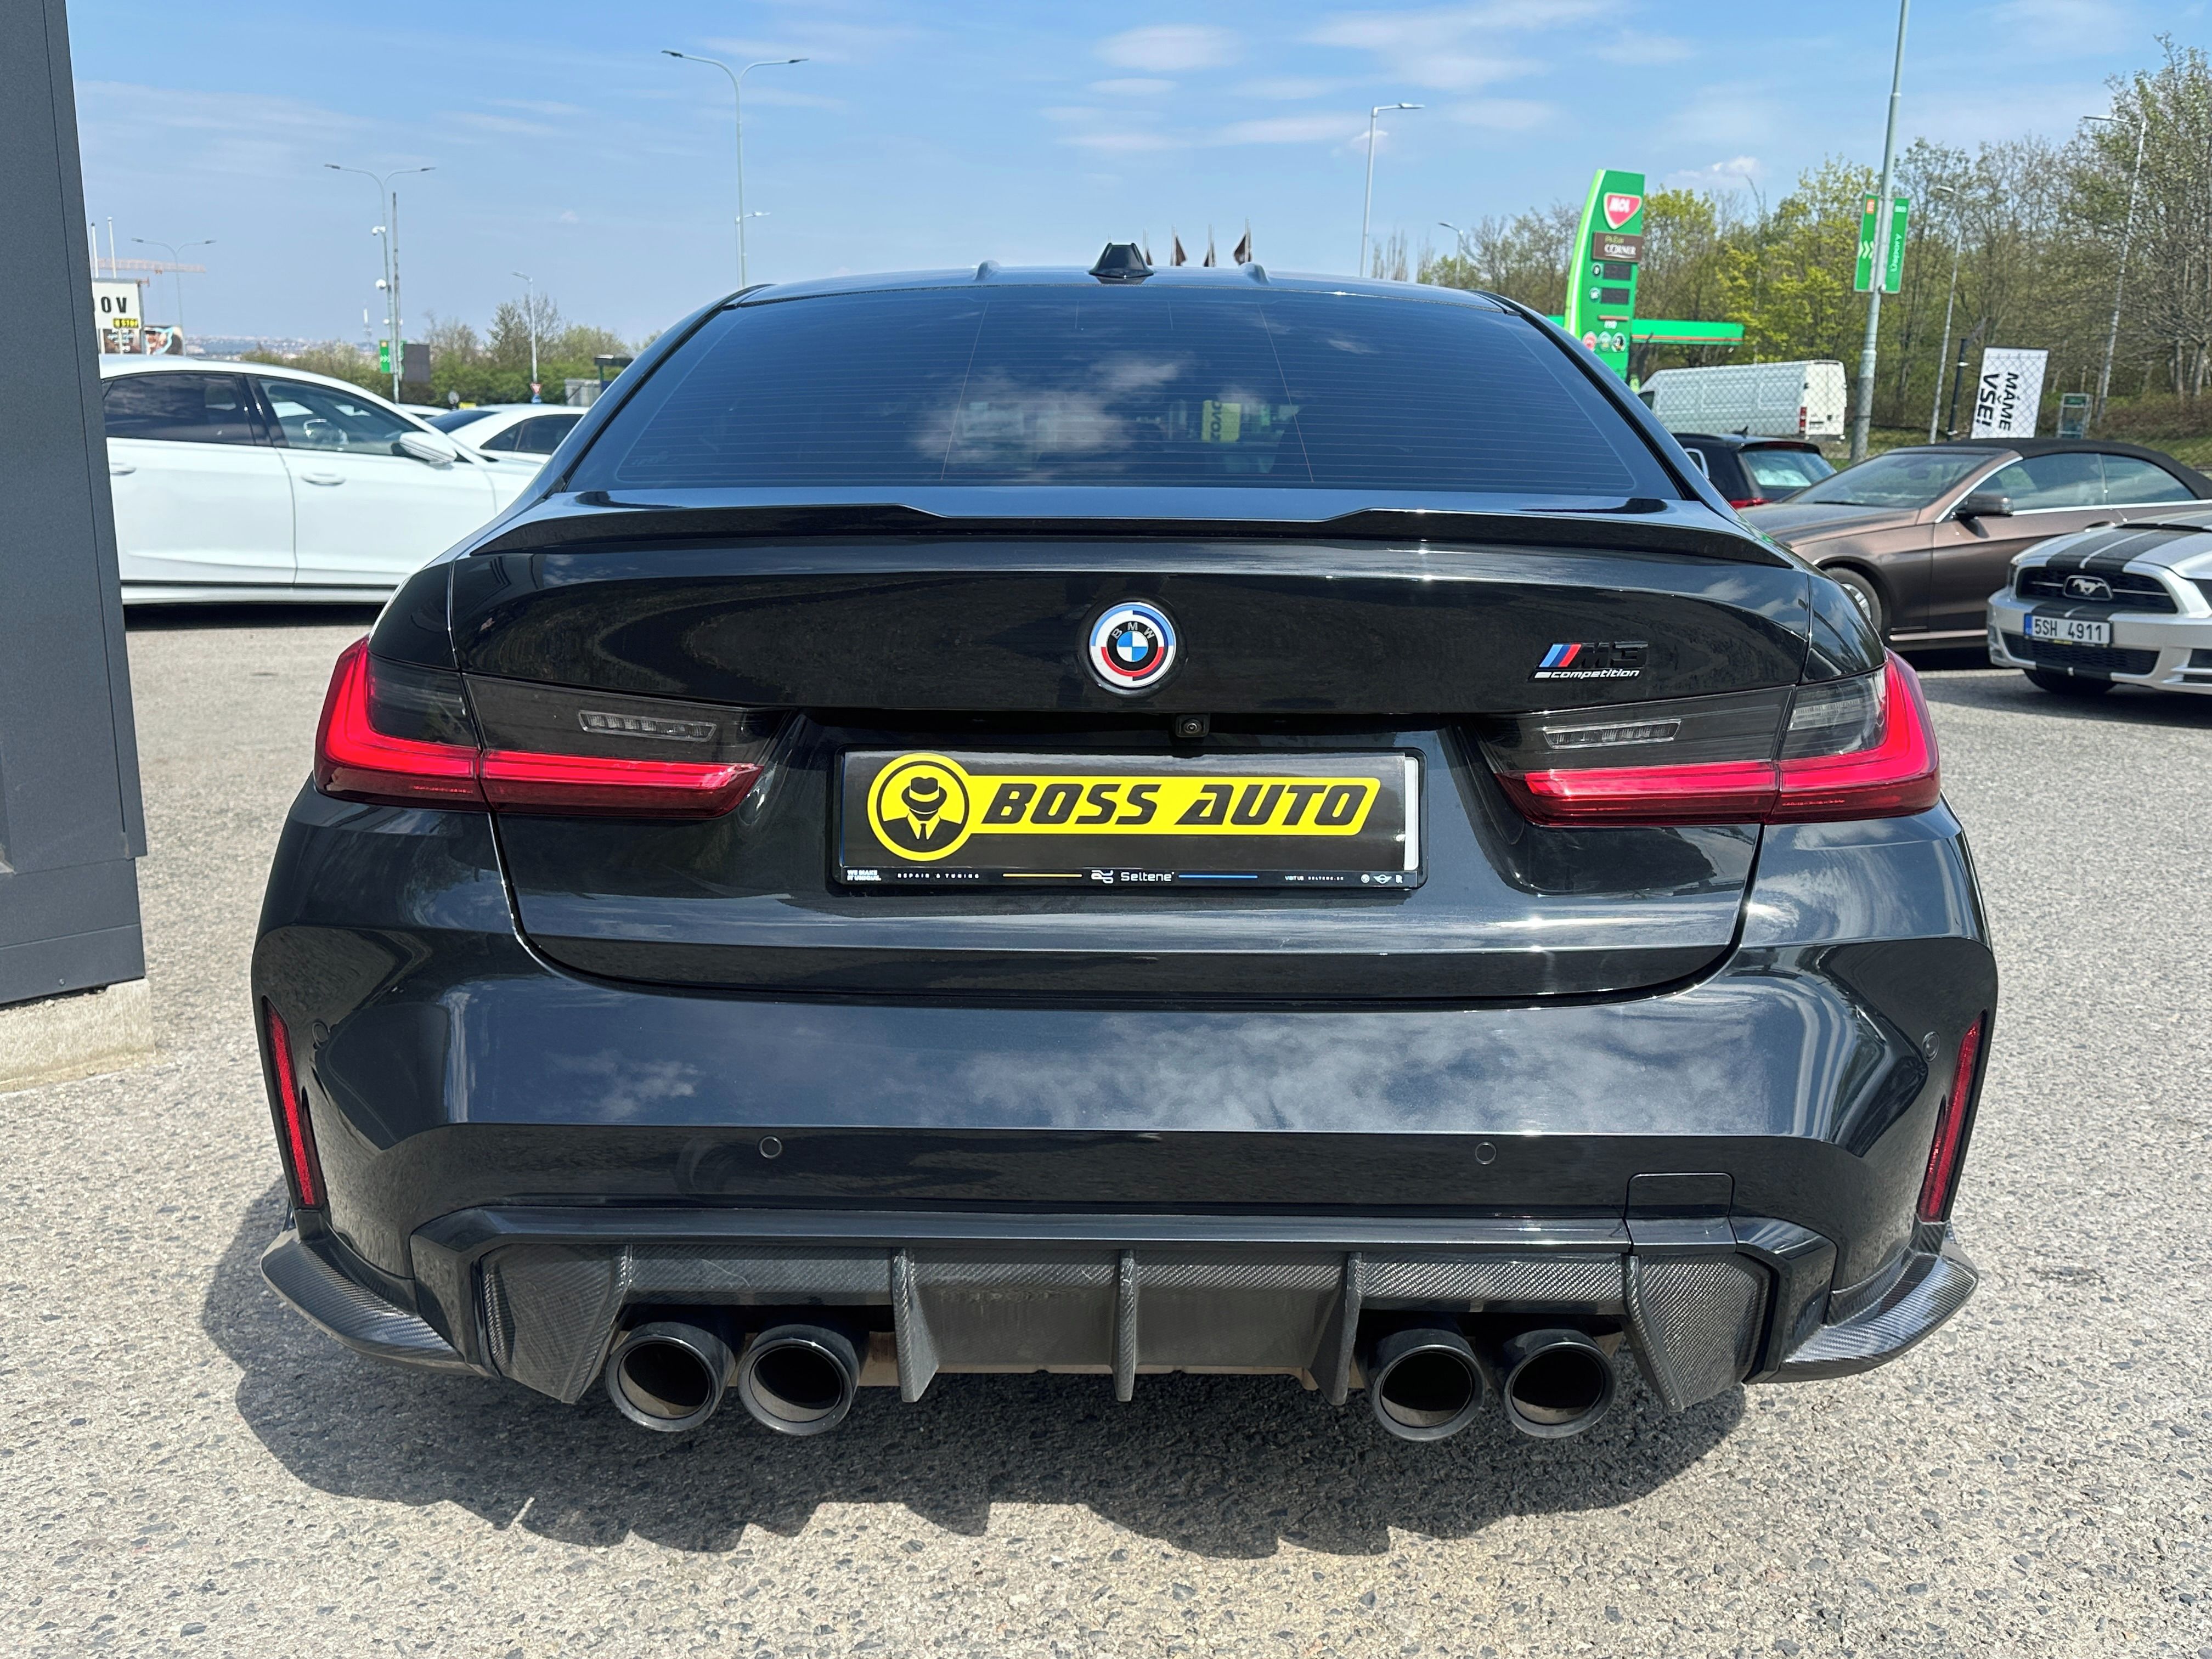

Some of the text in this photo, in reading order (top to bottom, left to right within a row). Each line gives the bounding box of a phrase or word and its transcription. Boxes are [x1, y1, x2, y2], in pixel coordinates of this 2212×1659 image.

[1976, 374, 2001, 426] VŠE!
[1999, 372, 2020, 431] MÁME
[1111, 622, 1155, 640] BMW
[2035, 619, 2102, 641] 5SH 4911
[1568, 641, 1648, 668] M3
[1551, 668, 1640, 680] competition
[982, 783, 1368, 826] BOSS AUTO
